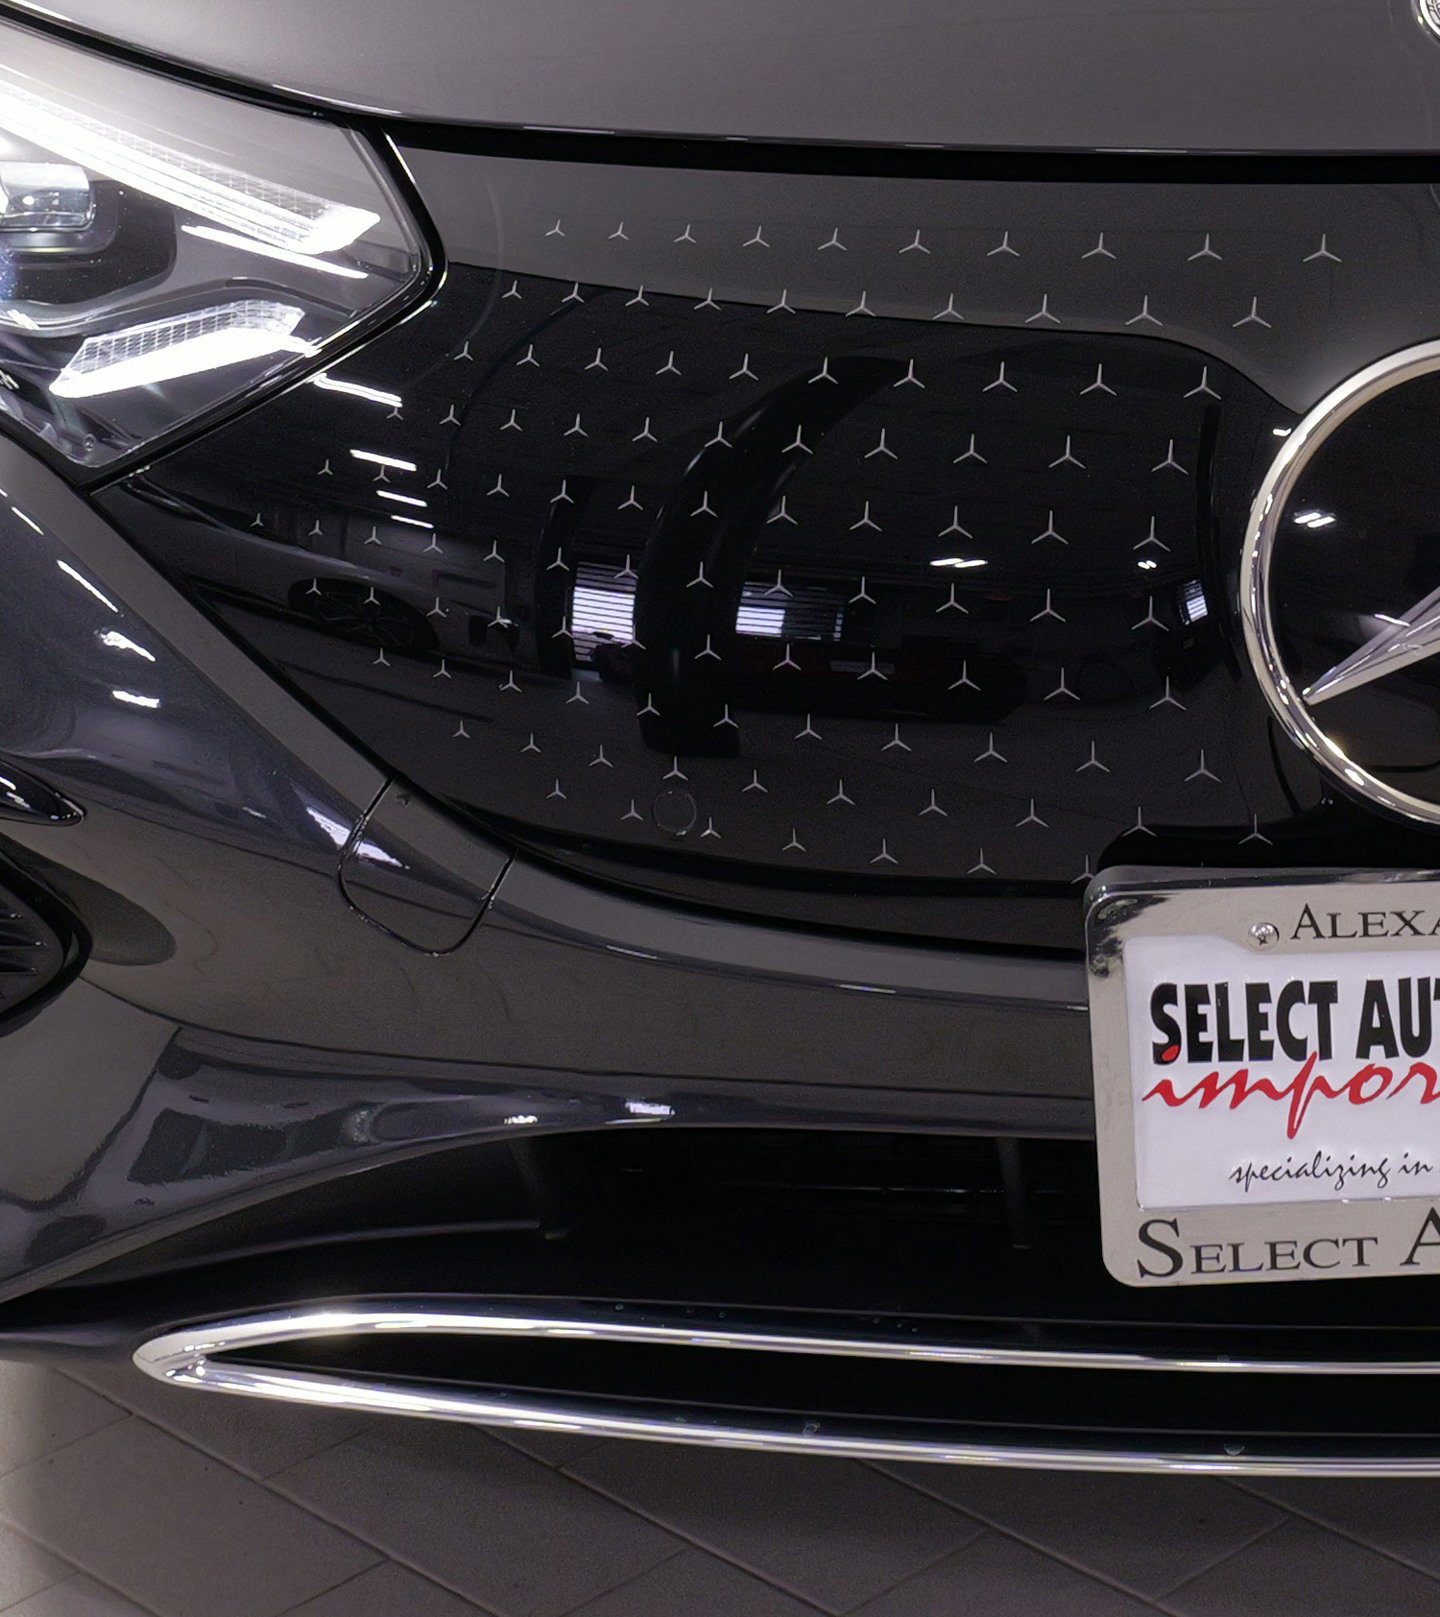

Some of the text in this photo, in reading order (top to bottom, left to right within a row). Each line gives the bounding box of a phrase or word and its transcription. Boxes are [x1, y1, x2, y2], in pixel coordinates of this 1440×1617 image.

[1150, 980, 1339, 1065] SELECT
[1229, 1150, 1391, 1193] specializing
[1398, 1152, 1434, 1174] in
[1137, 1218, 1379, 1279] SELECT
